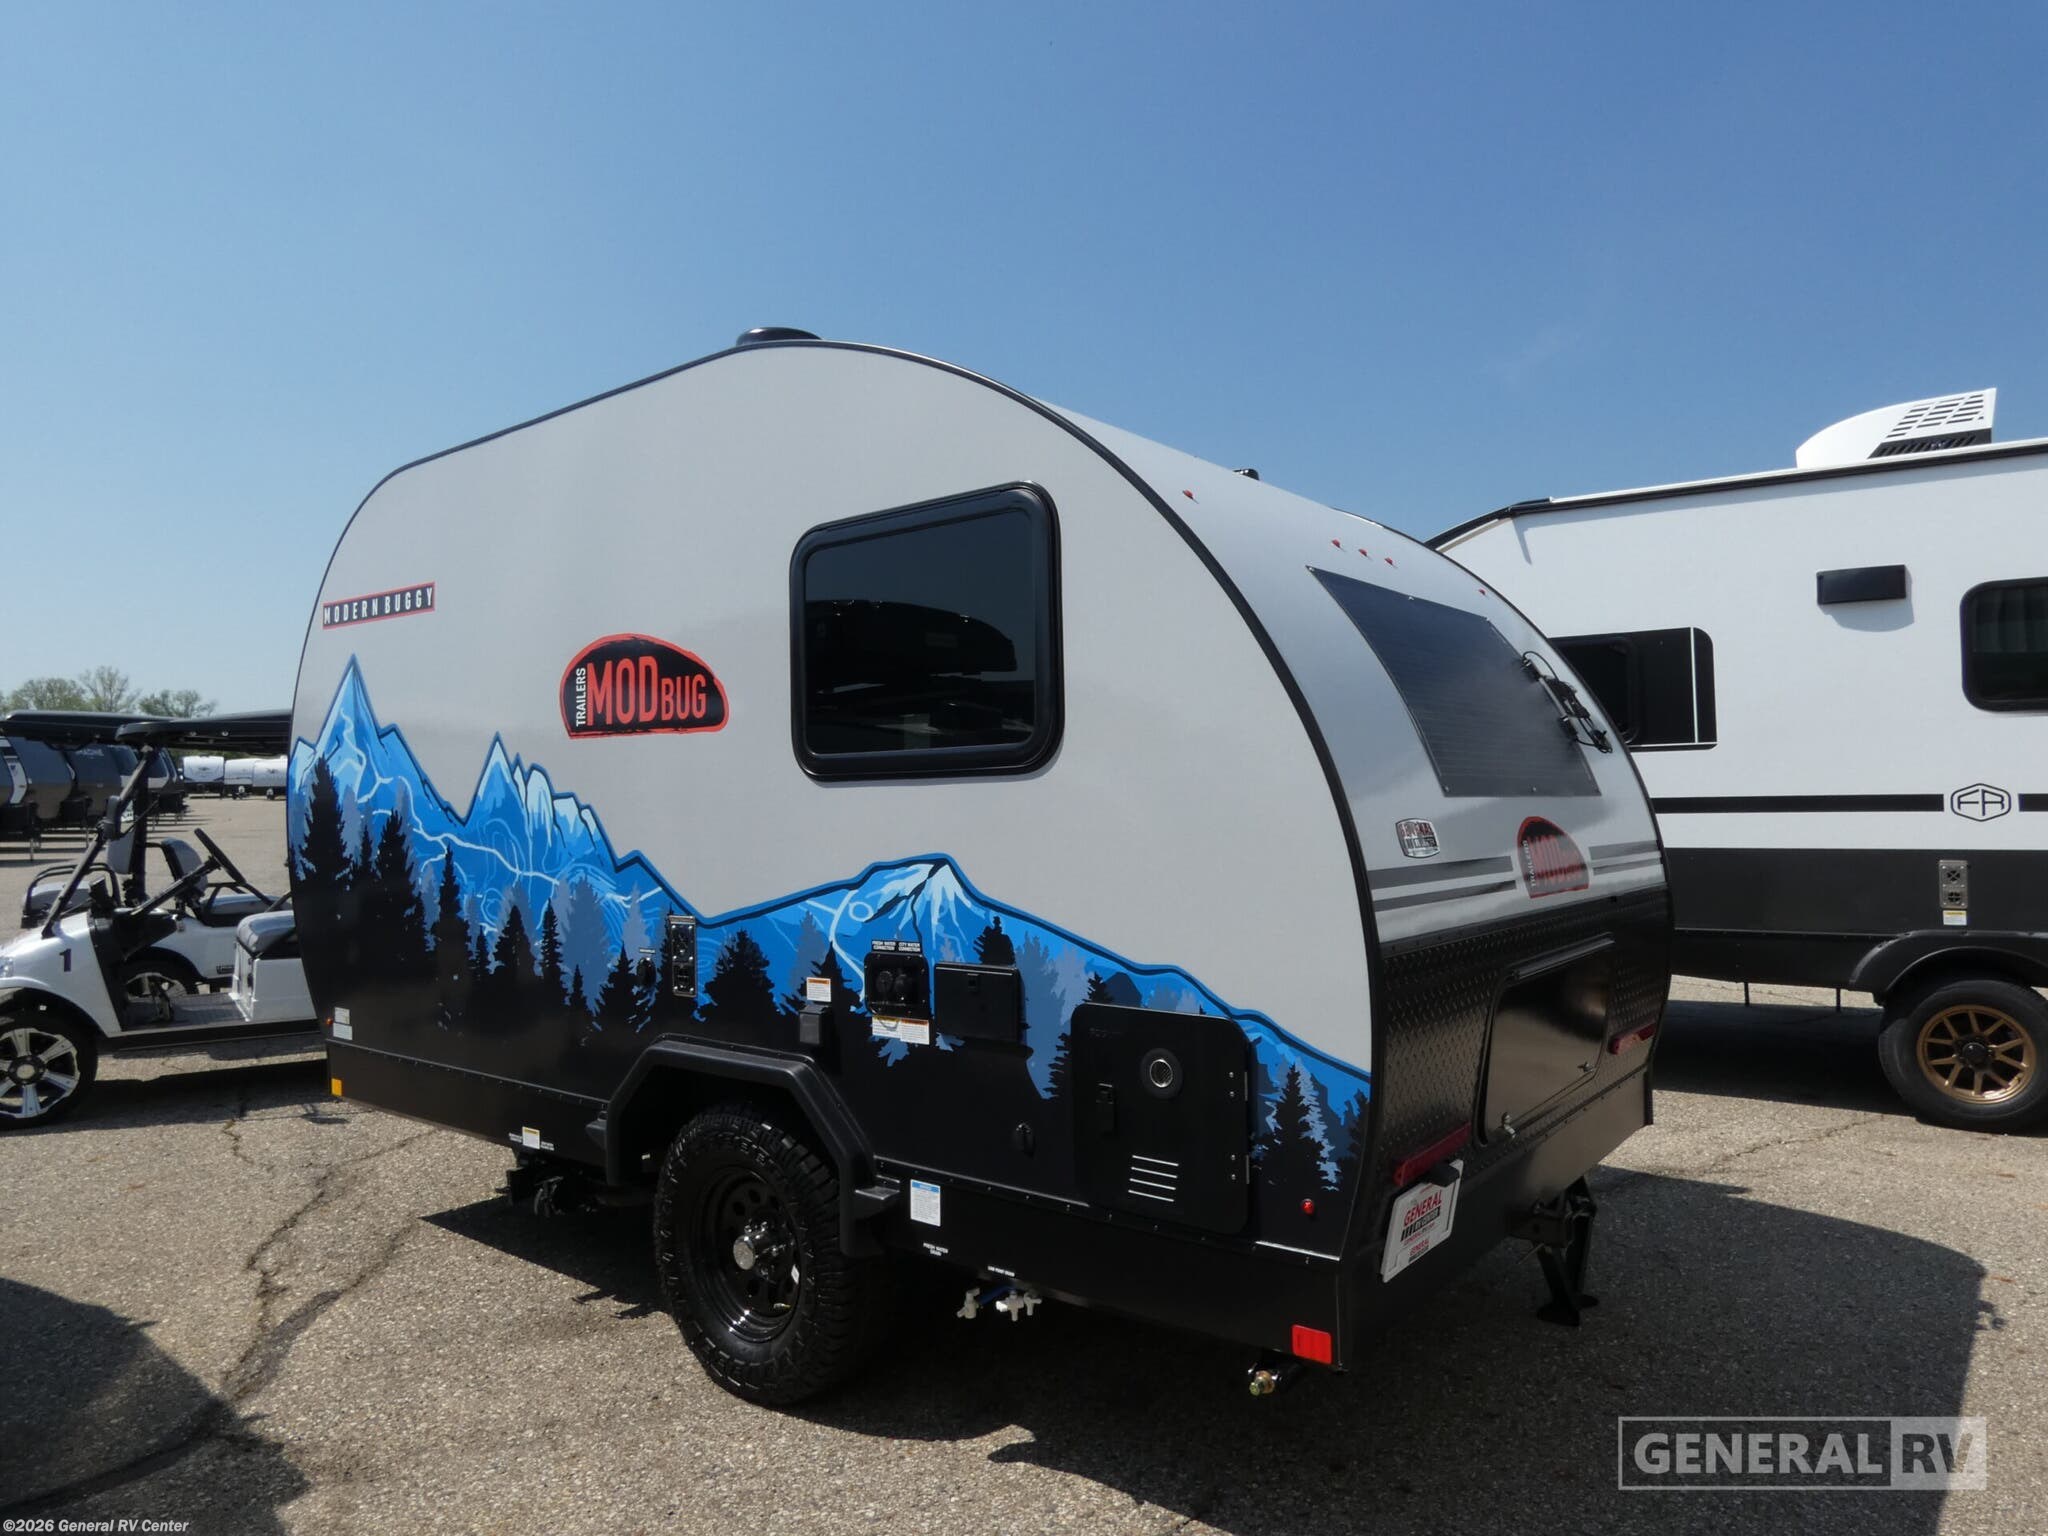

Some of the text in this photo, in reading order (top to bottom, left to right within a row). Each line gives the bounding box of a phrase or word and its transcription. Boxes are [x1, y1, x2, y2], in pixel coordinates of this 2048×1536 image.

[323, 586, 433, 625] MODERN BUGGY
[575, 667, 587, 727] TRAILERS
[59, 948, 72, 972] 1
[1404, 1189, 1442, 1228] GENERAL
